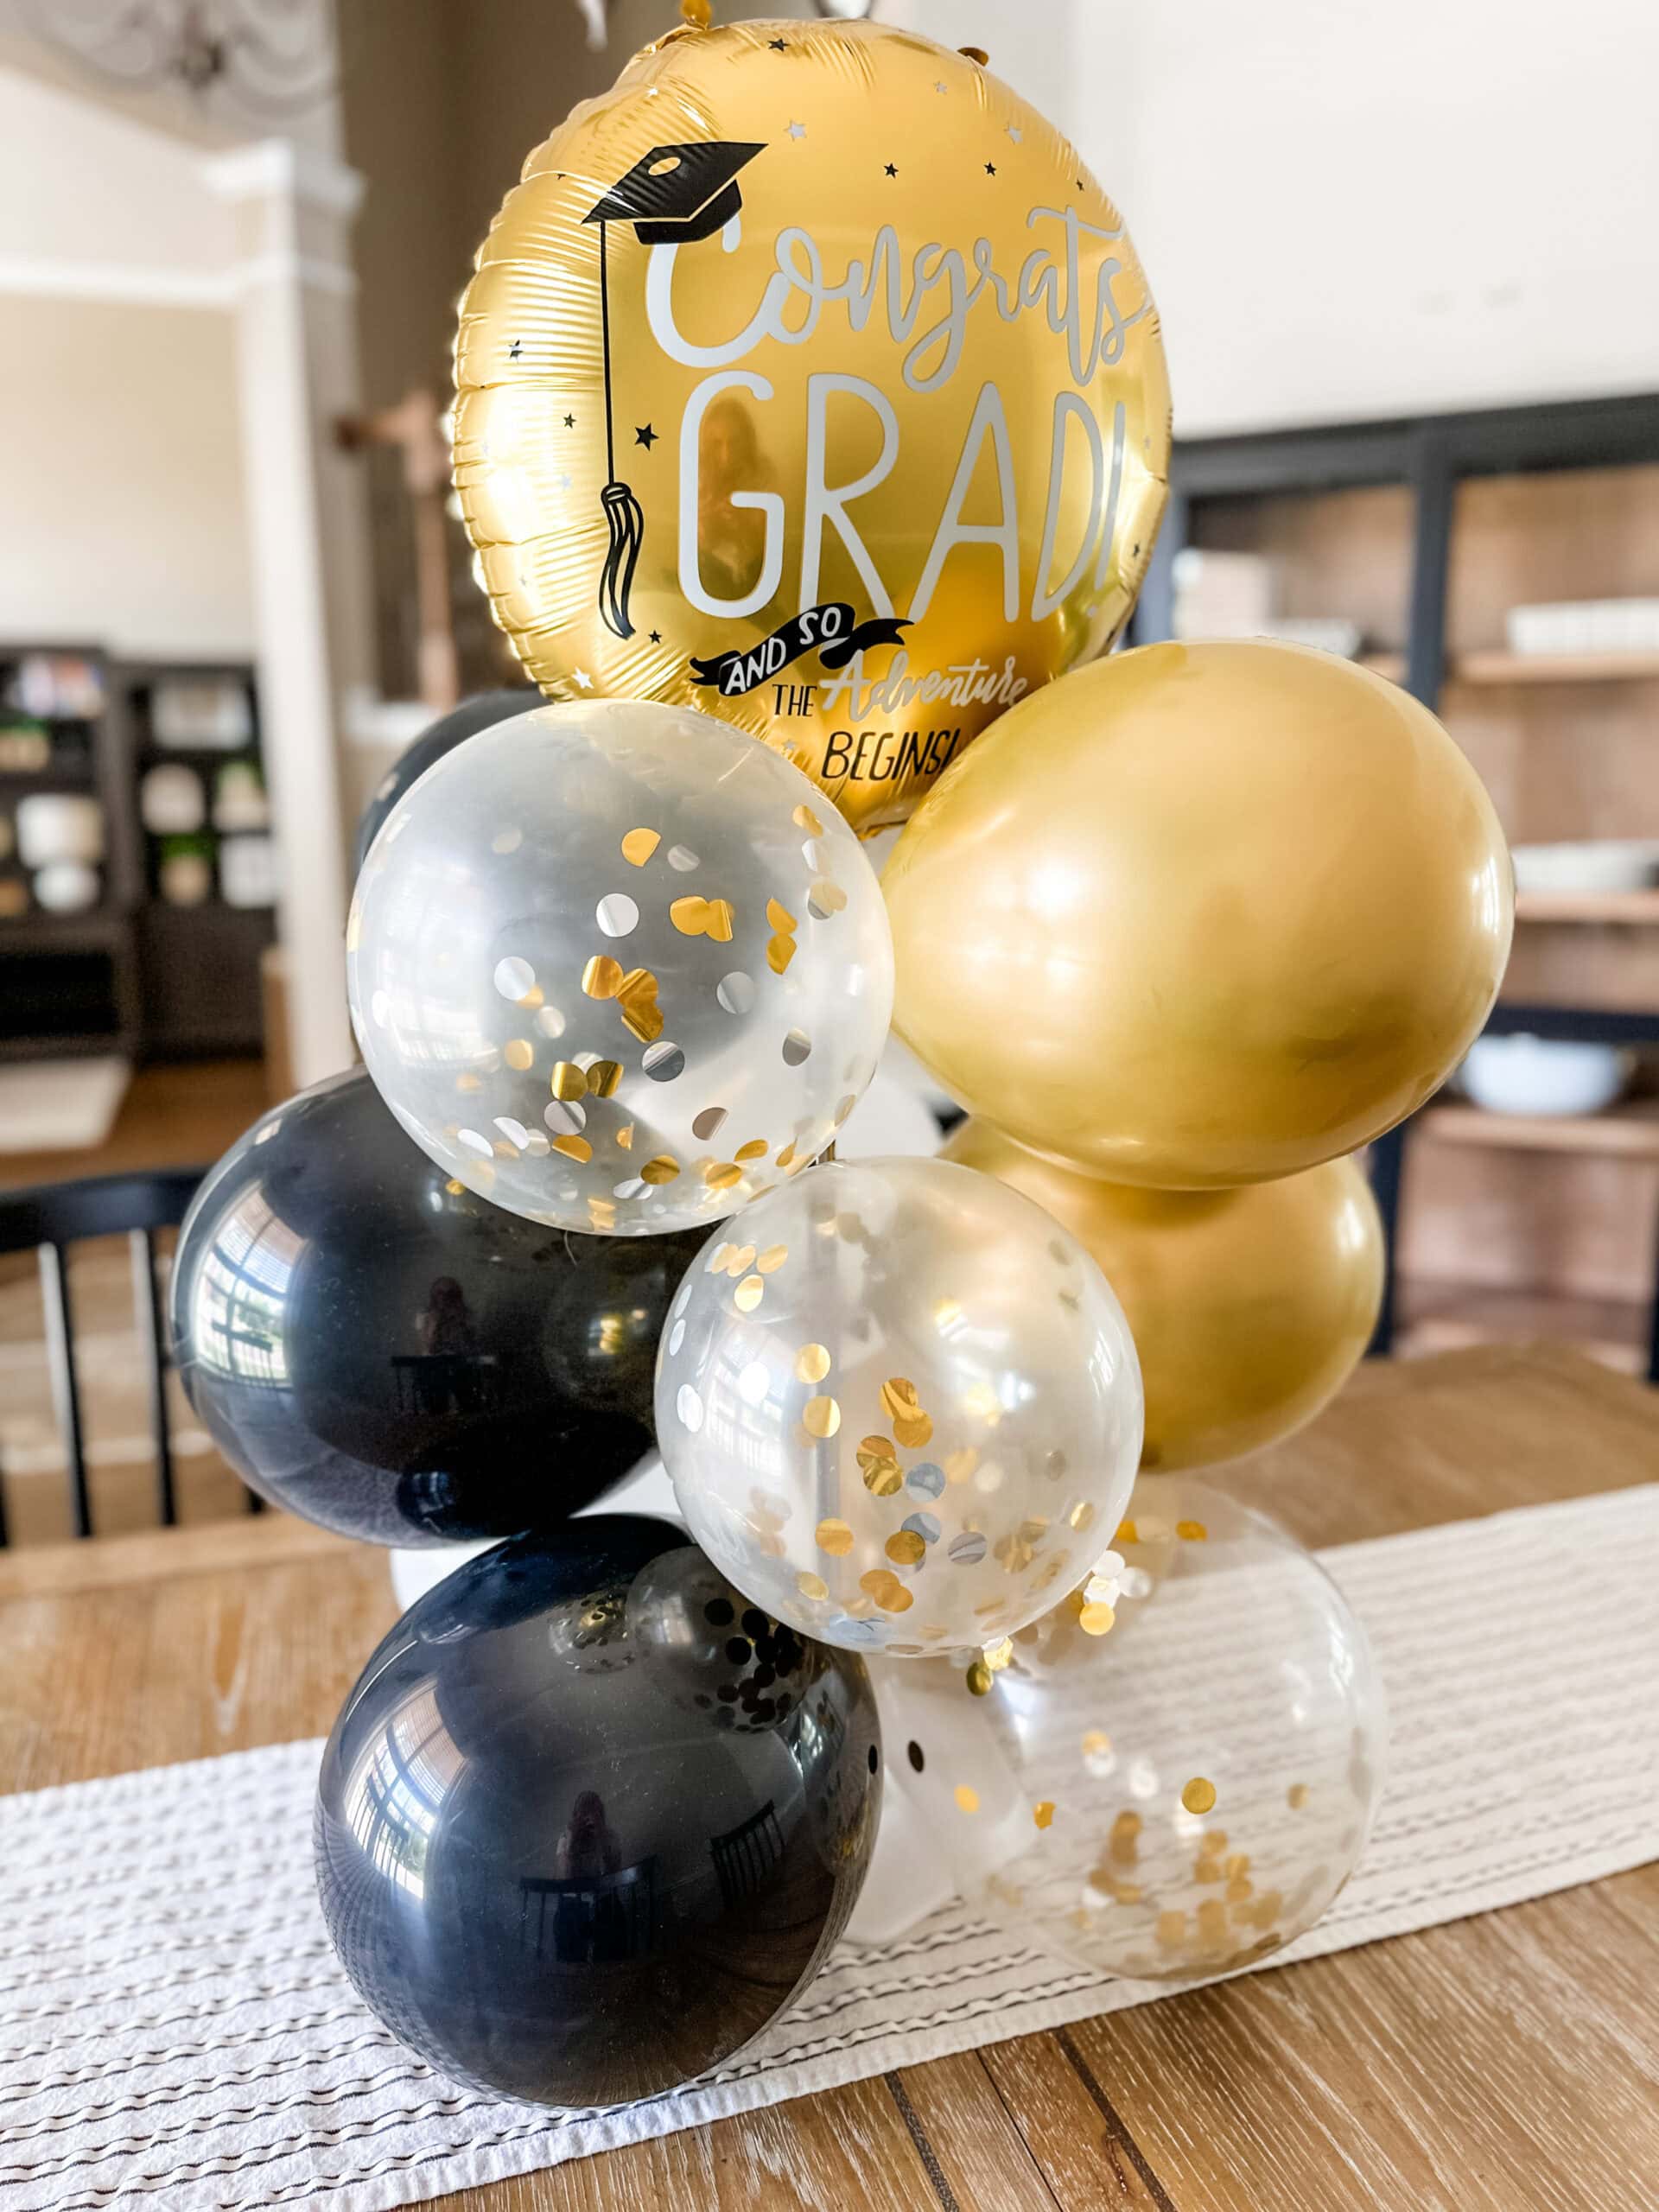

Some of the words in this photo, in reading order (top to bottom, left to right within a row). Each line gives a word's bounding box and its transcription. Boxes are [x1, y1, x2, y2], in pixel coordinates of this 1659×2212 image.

[646, 205, 1156, 393] Congrats
[677, 368, 1126, 623] GRAD!
[724, 636, 787, 696] AND
[798, 606, 842, 646] SO
[772, 683, 818, 718] THE
[819, 648, 1028, 723] Adventure
[821, 727, 962, 781] BEGINS!
